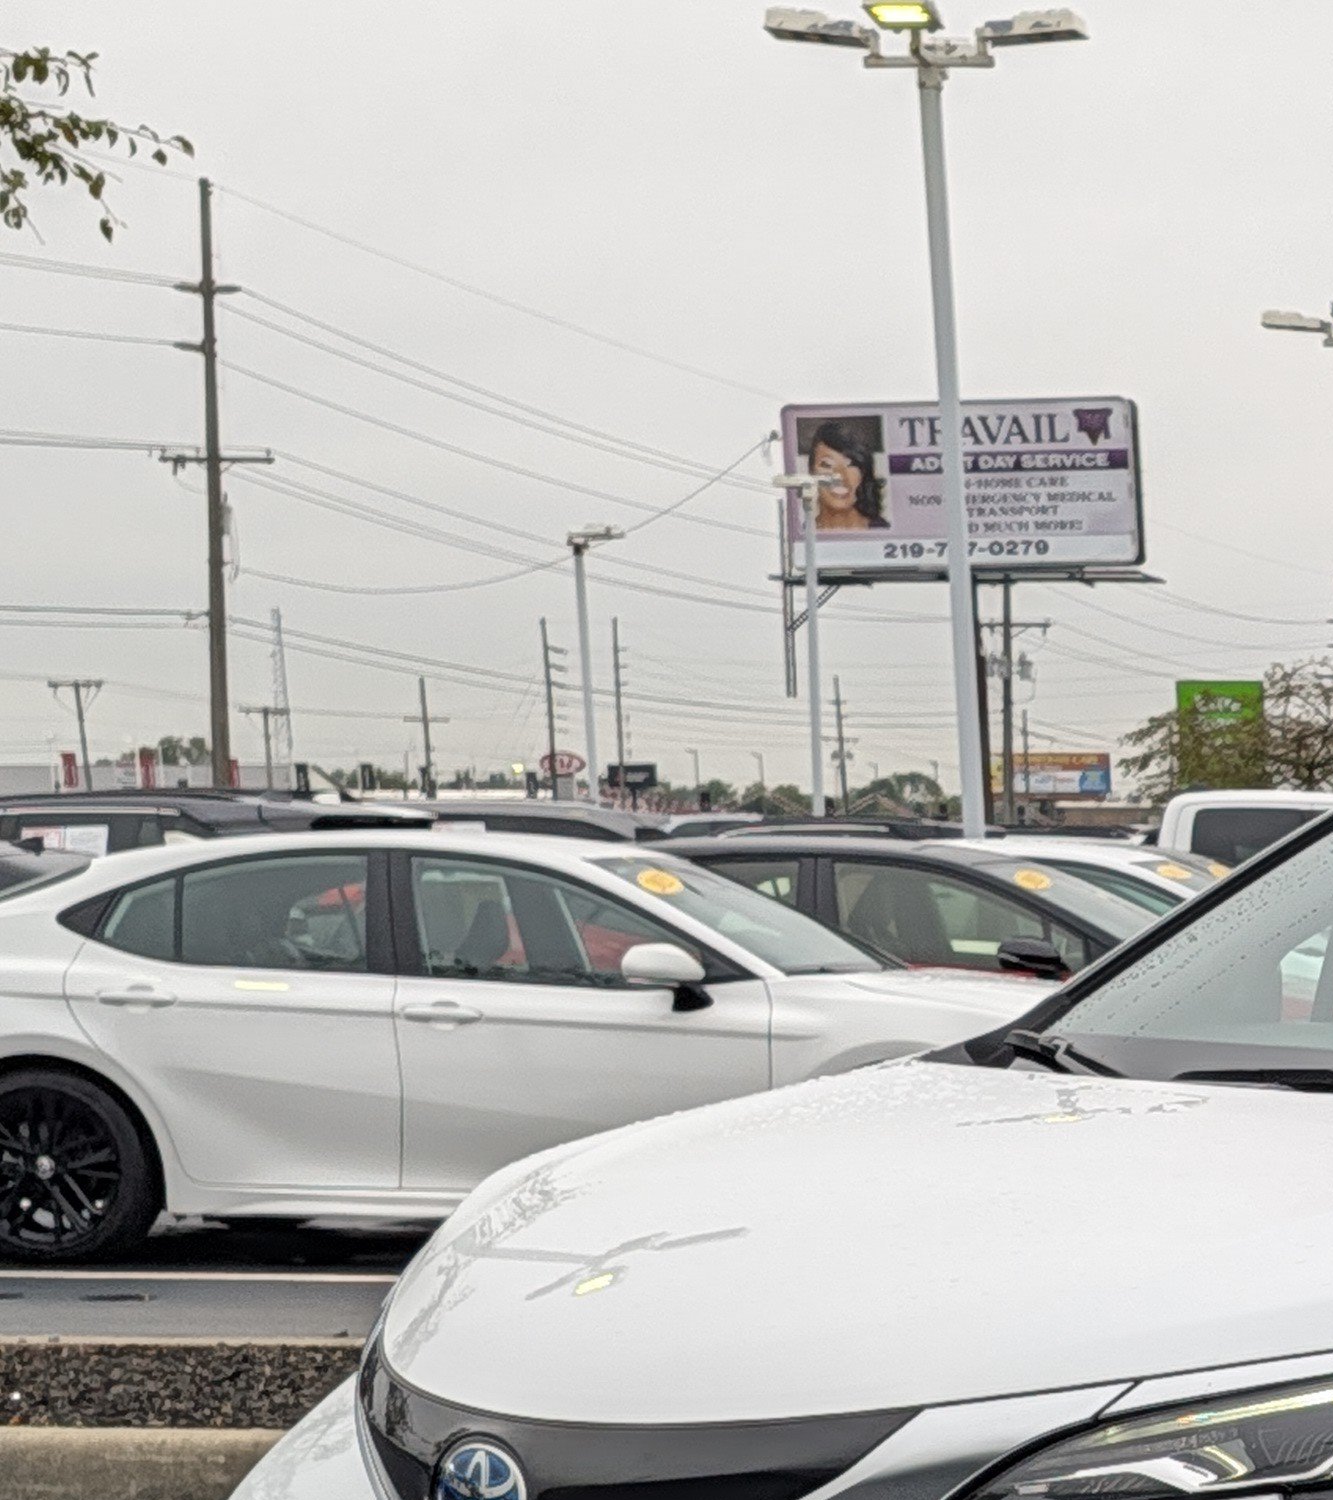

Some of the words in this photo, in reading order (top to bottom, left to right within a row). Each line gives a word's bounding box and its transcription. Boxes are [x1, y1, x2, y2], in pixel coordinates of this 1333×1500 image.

[911, 457, 974, 472] ADT
[978, 454, 1017, 470] DAY
[1020, 451, 1110, 469] SERVICE
[883, 539, 1050, 558] 219-77-0279
